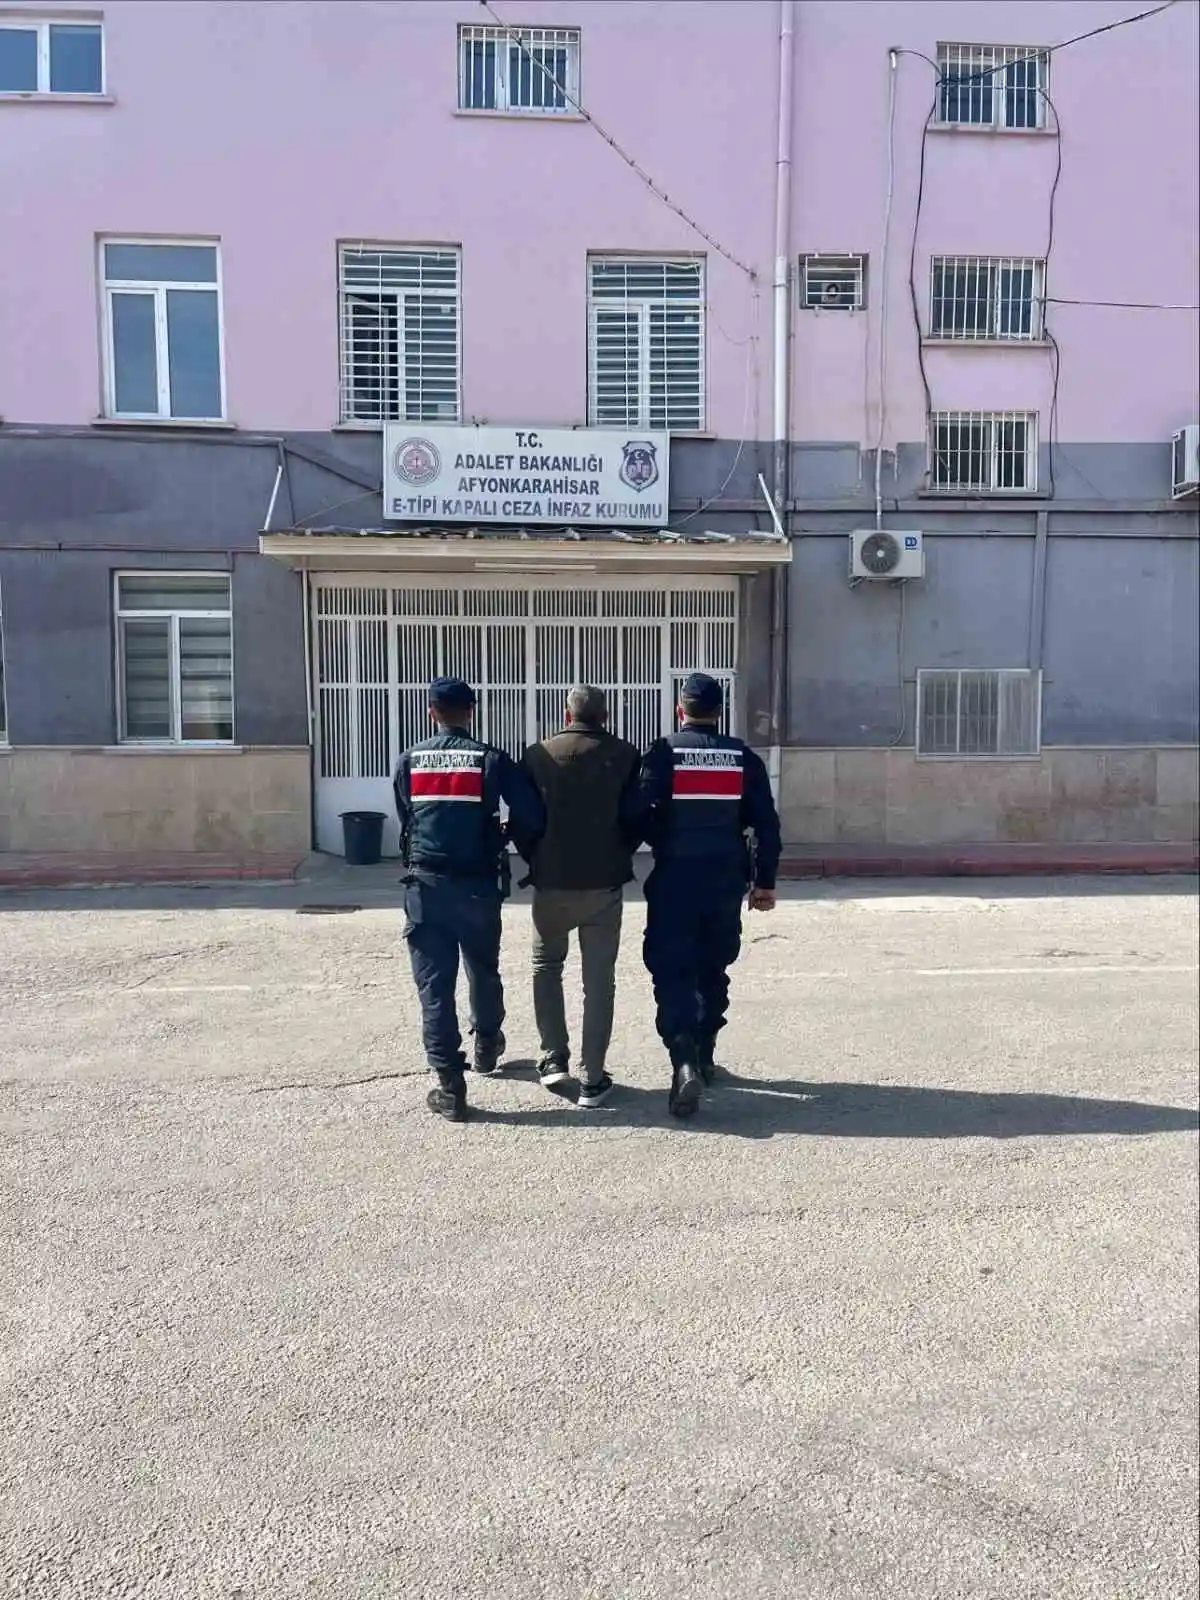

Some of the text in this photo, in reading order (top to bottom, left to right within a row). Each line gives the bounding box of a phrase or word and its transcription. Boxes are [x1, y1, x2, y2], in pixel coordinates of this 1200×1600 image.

[515, 432, 543, 448] T.C.
[454, 453, 603, 473] ADALET BAKANLIĞI
[458, 476, 600, 496] AFYONKARAHİSAR
[393, 496, 663, 519] E-TİPİ KAPALI CEZA İNFAZ KURUMU
[416, 753, 475, 769] JANDARMA
[682, 751, 737, 768] JANDARMA
